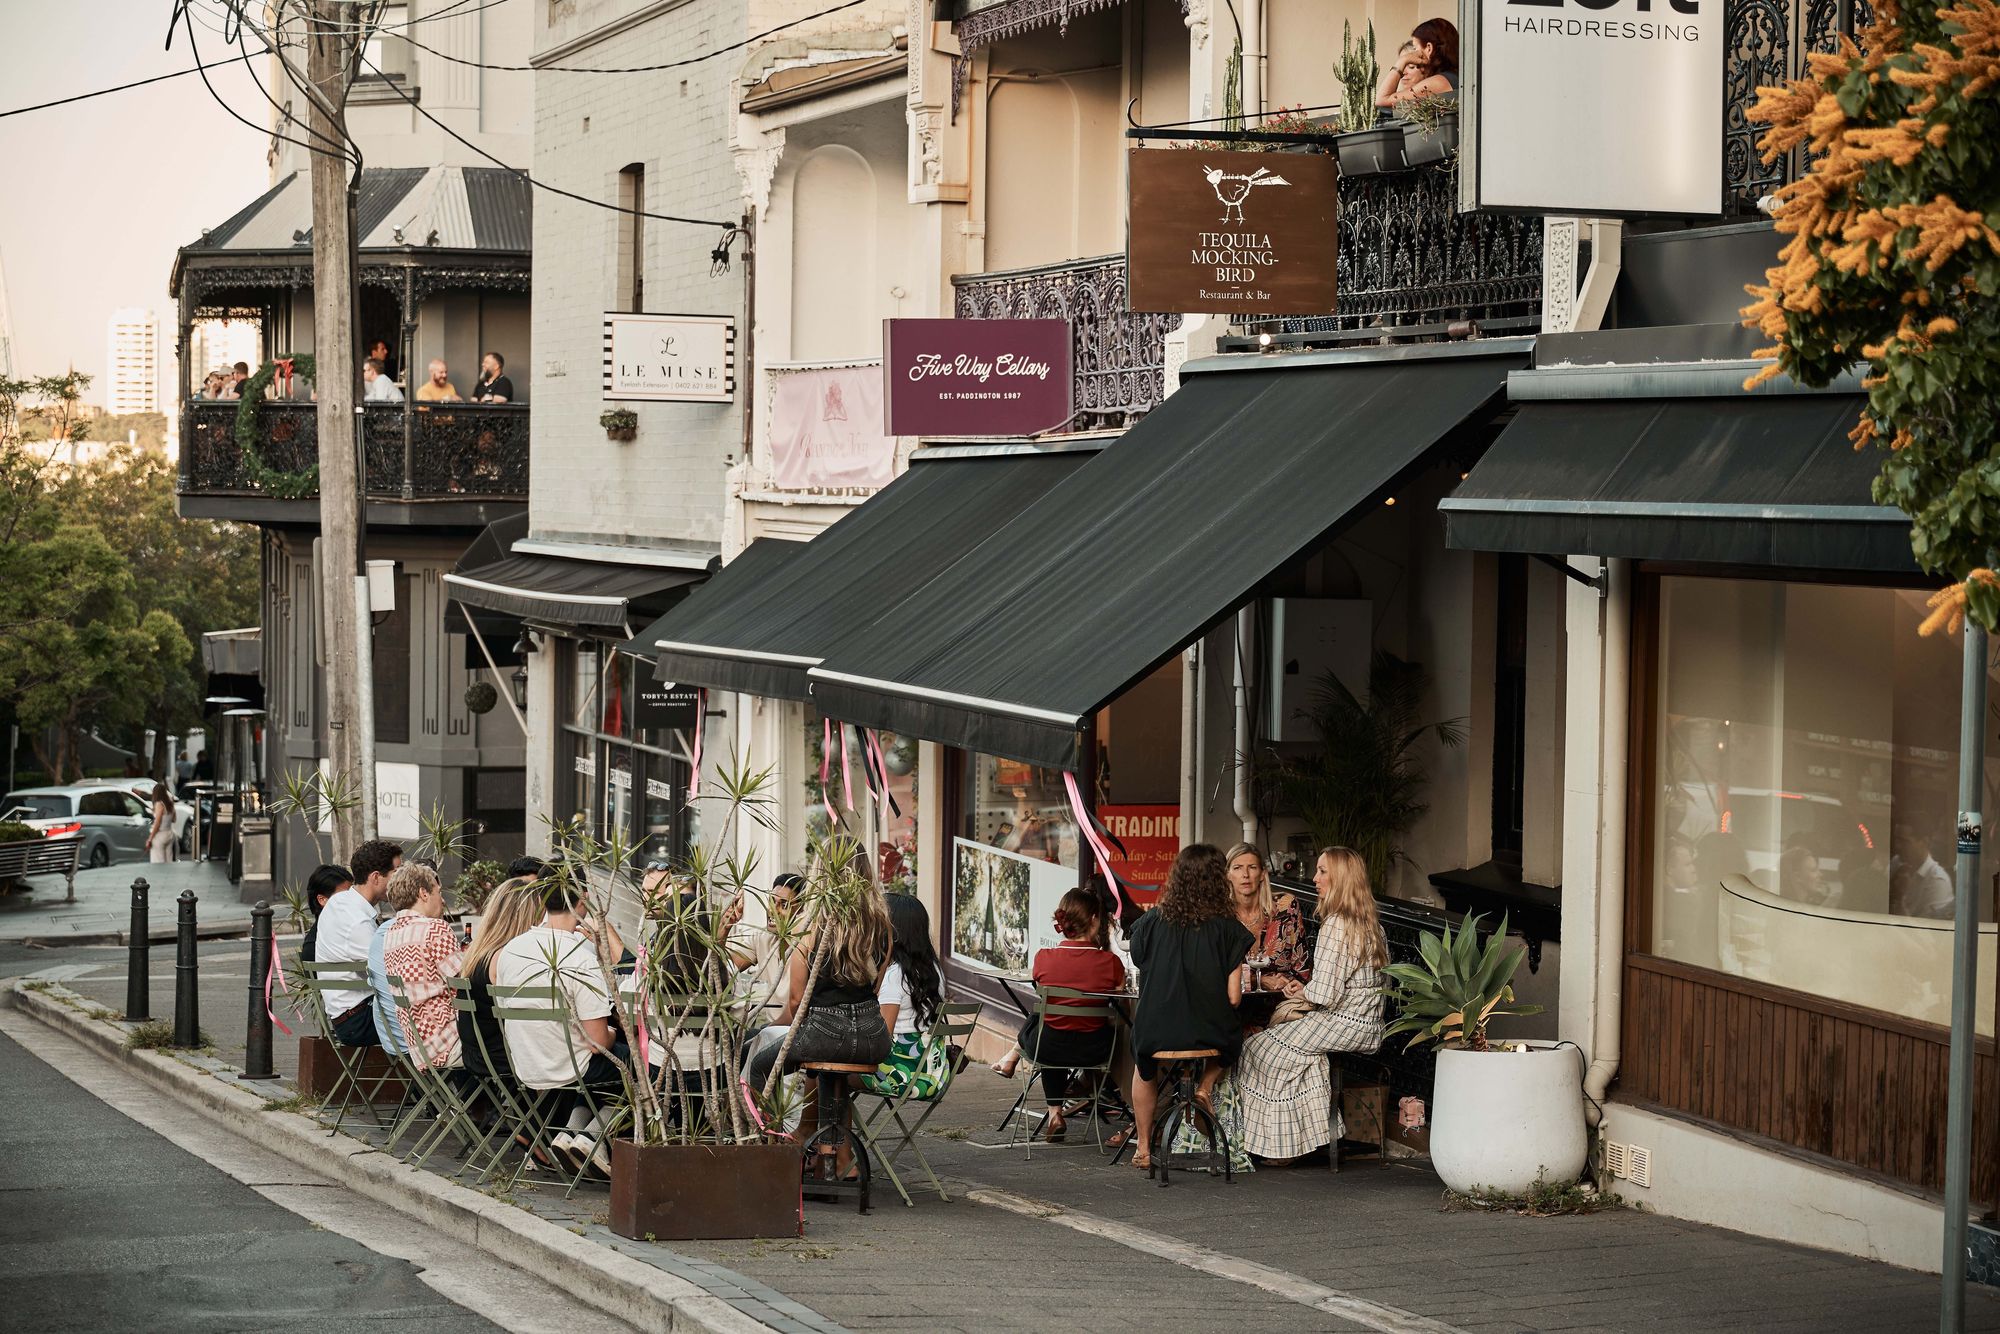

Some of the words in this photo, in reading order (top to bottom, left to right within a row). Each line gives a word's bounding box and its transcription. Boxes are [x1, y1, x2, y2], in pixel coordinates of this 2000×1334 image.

[1505, 16, 1699, 41] HAIRDRESSING
[1199, 232, 1272, 252] TEQUILA
[1191, 249, 1279, 266] MOCKING-
[1215, 267, 1255, 282] BIRD
[1199, 289, 1243, 300] Restaurant
[1245, 290, 1254, 300] &
[1257, 290, 1271, 300] Bar
[621, 364, 646, 378] LE
[661, 365, 718, 380] MUSE
[908, 353, 953, 382] Five
[954, 353, 993, 383] Way
[995, 353, 1051, 381] Cellars
[939, 392, 954, 400] EST.
[956, 392, 1001, 400] PADDINGTON
[1003, 392, 1022, 400] 1987
[376, 791, 413, 808] HOTEL
[1109, 848, 1148, 867] oday
